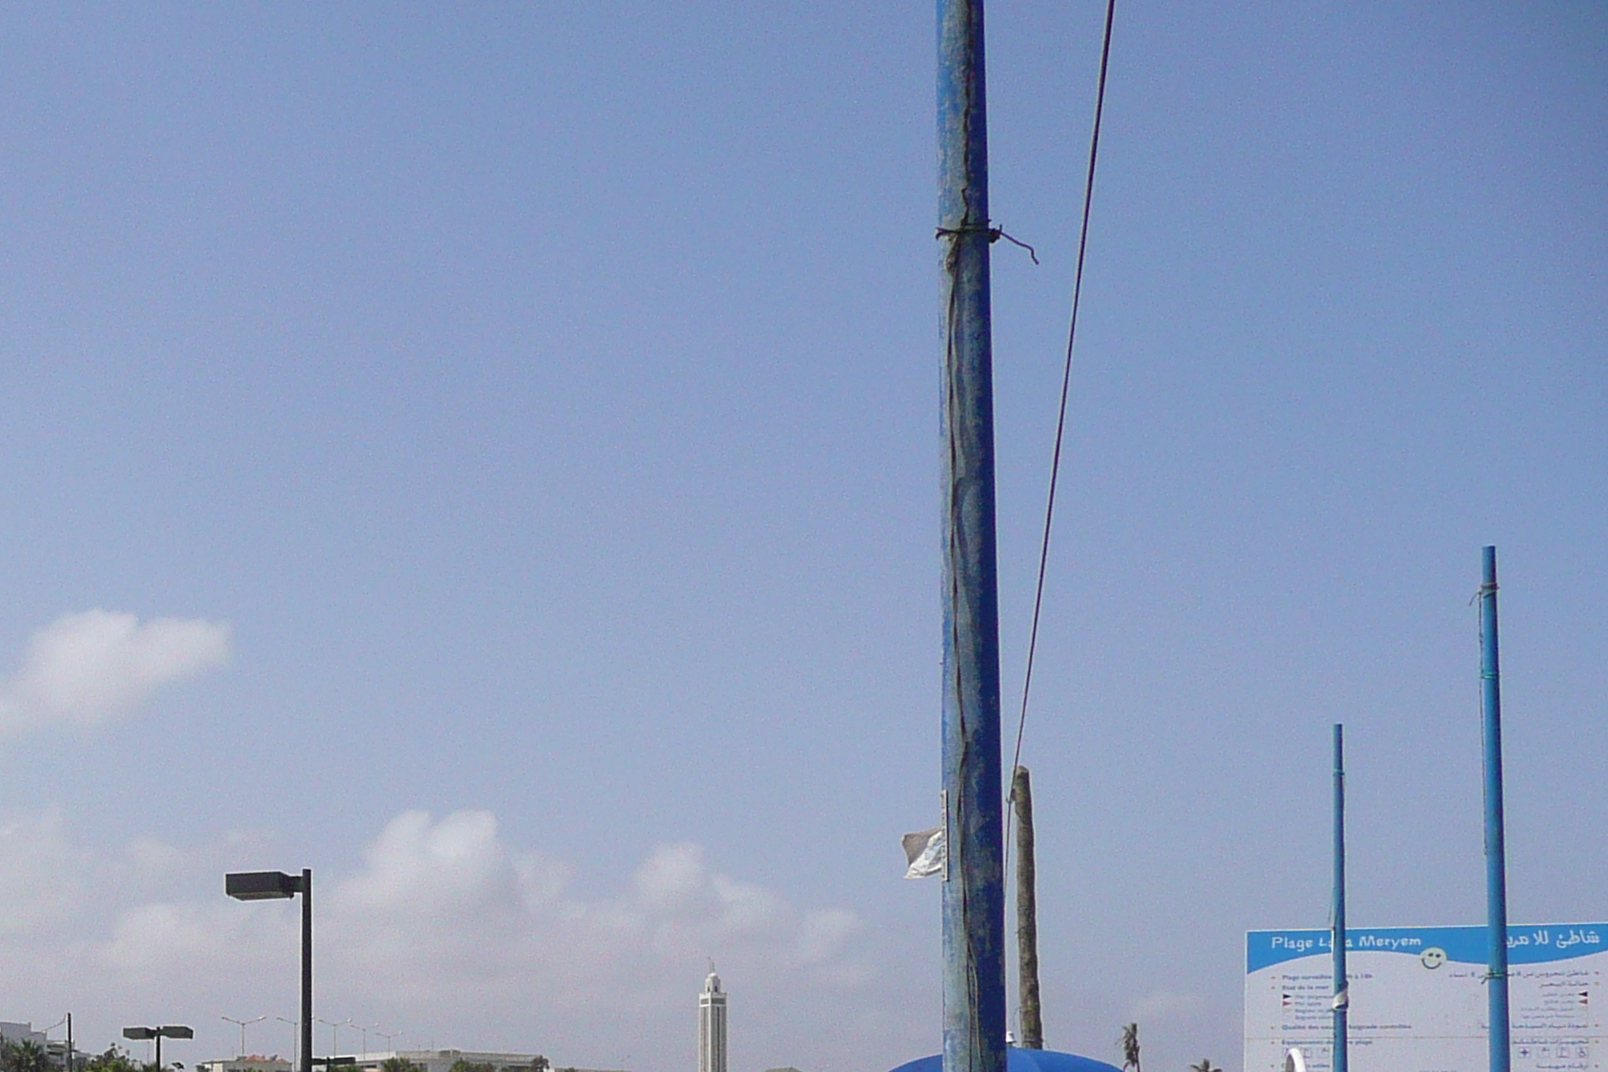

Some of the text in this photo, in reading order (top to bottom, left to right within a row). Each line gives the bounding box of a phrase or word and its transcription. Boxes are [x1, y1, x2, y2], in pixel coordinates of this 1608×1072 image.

[1271, 936, 1313, 952] Plage
[1358, 935, 1422, 950] Meryem
[1533, 930, 1549, 945] للا
[1556, 929, 1601, 949] شاطئ
